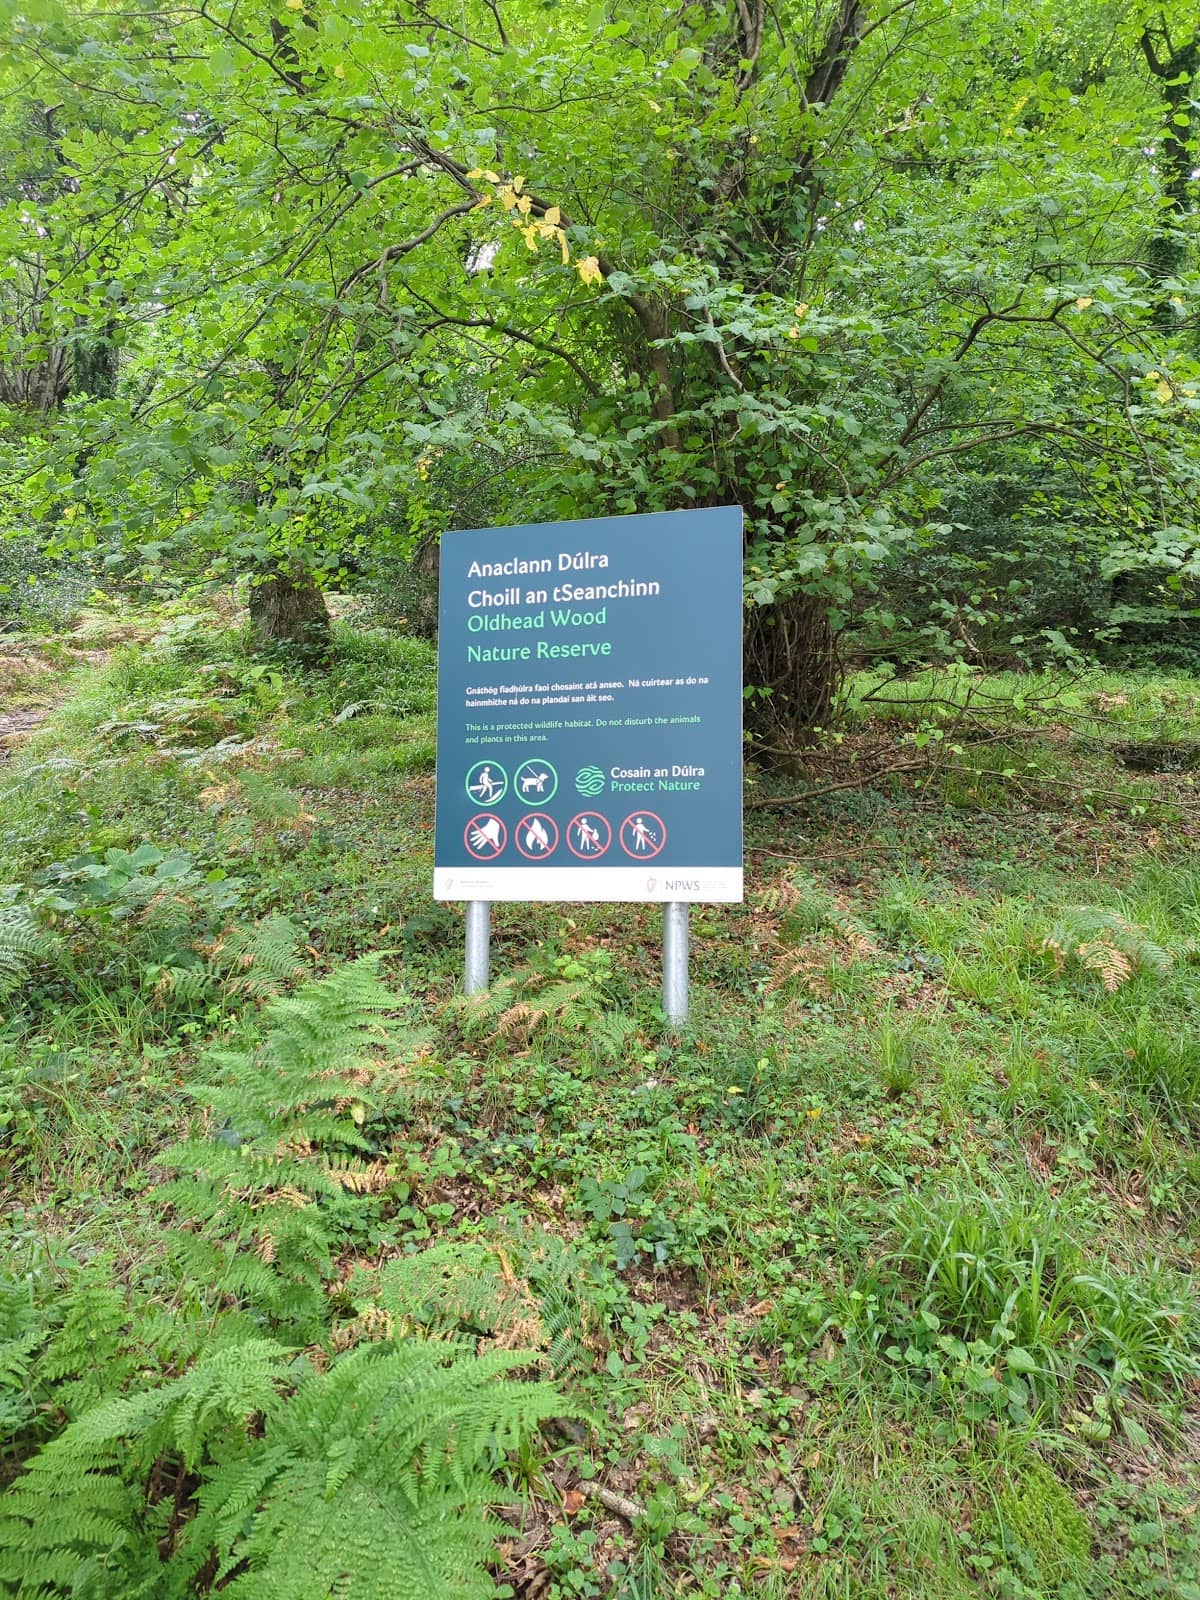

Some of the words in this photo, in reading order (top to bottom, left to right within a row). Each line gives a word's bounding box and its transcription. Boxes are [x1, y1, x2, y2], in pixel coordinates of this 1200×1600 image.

[467, 557, 552, 578] Anaclann
[558, 552, 609, 571] Dúlra
[467, 588, 520, 608] Choill
[525, 589, 547, 604] an
[553, 579, 660, 602] tSeanchinn
[467, 611, 545, 632] Oldhead
[550, 607, 607, 627] Wood
[467, 645, 531, 663] Nature
[537, 641, 612, 659] Reserve
[535, 683, 550, 692] faoi
[551, 682, 584, 691] chosaint
[599, 681, 625, 690] anseo.
[641, 678, 673, 688] cuirtear
[572, 695, 585, 703] san
[465, 723, 481, 731] This
[496, 720, 533, 731] protected
[534, 719, 563, 729] wildlife
[564, 719, 594, 728] habitat.
[609, 718, 623, 726] not
[624, 716, 653, 726] disturb
[654, 716, 669, 725] the
[670, 714, 702, 724] animals
[465, 736, 479, 744] and
[480, 735, 503, 745] plants
[513, 733, 528, 742] this
[529, 734, 549, 742] area.
[610, 766, 651, 779] Cosain
[653, 768, 669, 778] an
[671, 764, 705, 778] Dúlra
[611, 780, 655, 792] Protect
[658, 779, 701, 791] Nature
[665, 880, 700, 891] NPWS
